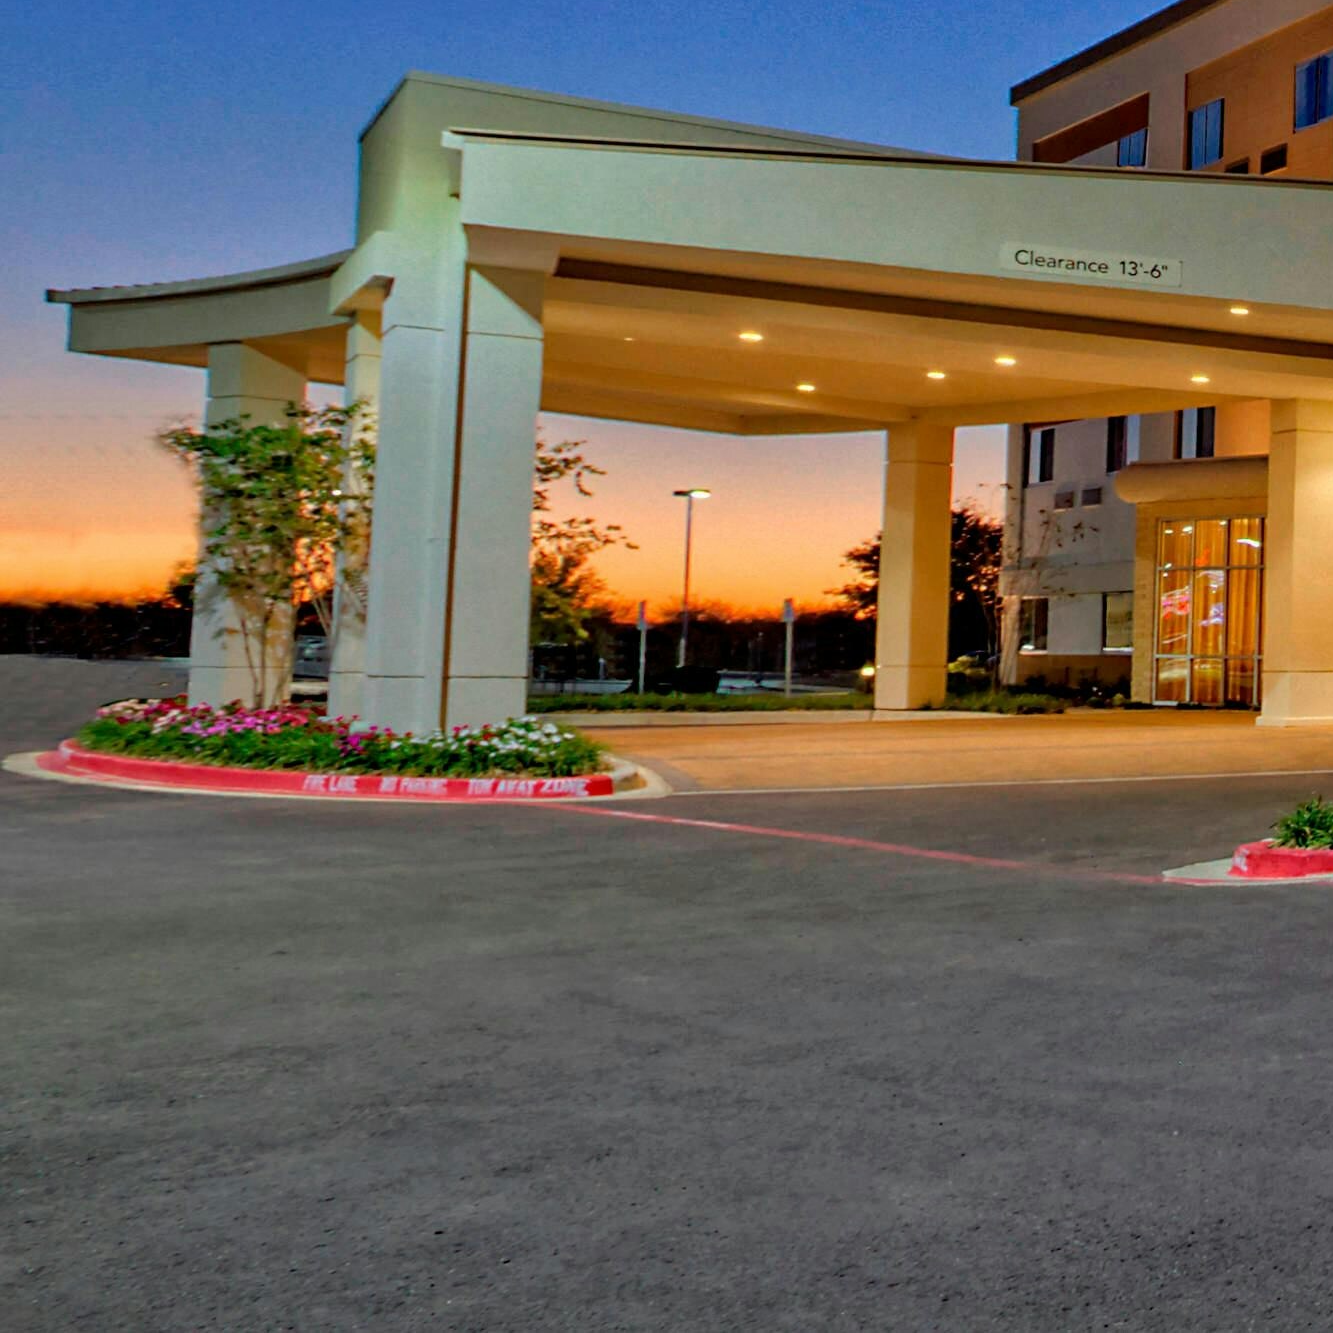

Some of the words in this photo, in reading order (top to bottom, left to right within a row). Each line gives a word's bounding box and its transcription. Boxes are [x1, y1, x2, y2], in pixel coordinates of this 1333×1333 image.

[1014, 249, 1109, 274] Clearance
[1119, 260, 1168, 279] 13'-6"
[541, 777, 590, 797] ZONE
